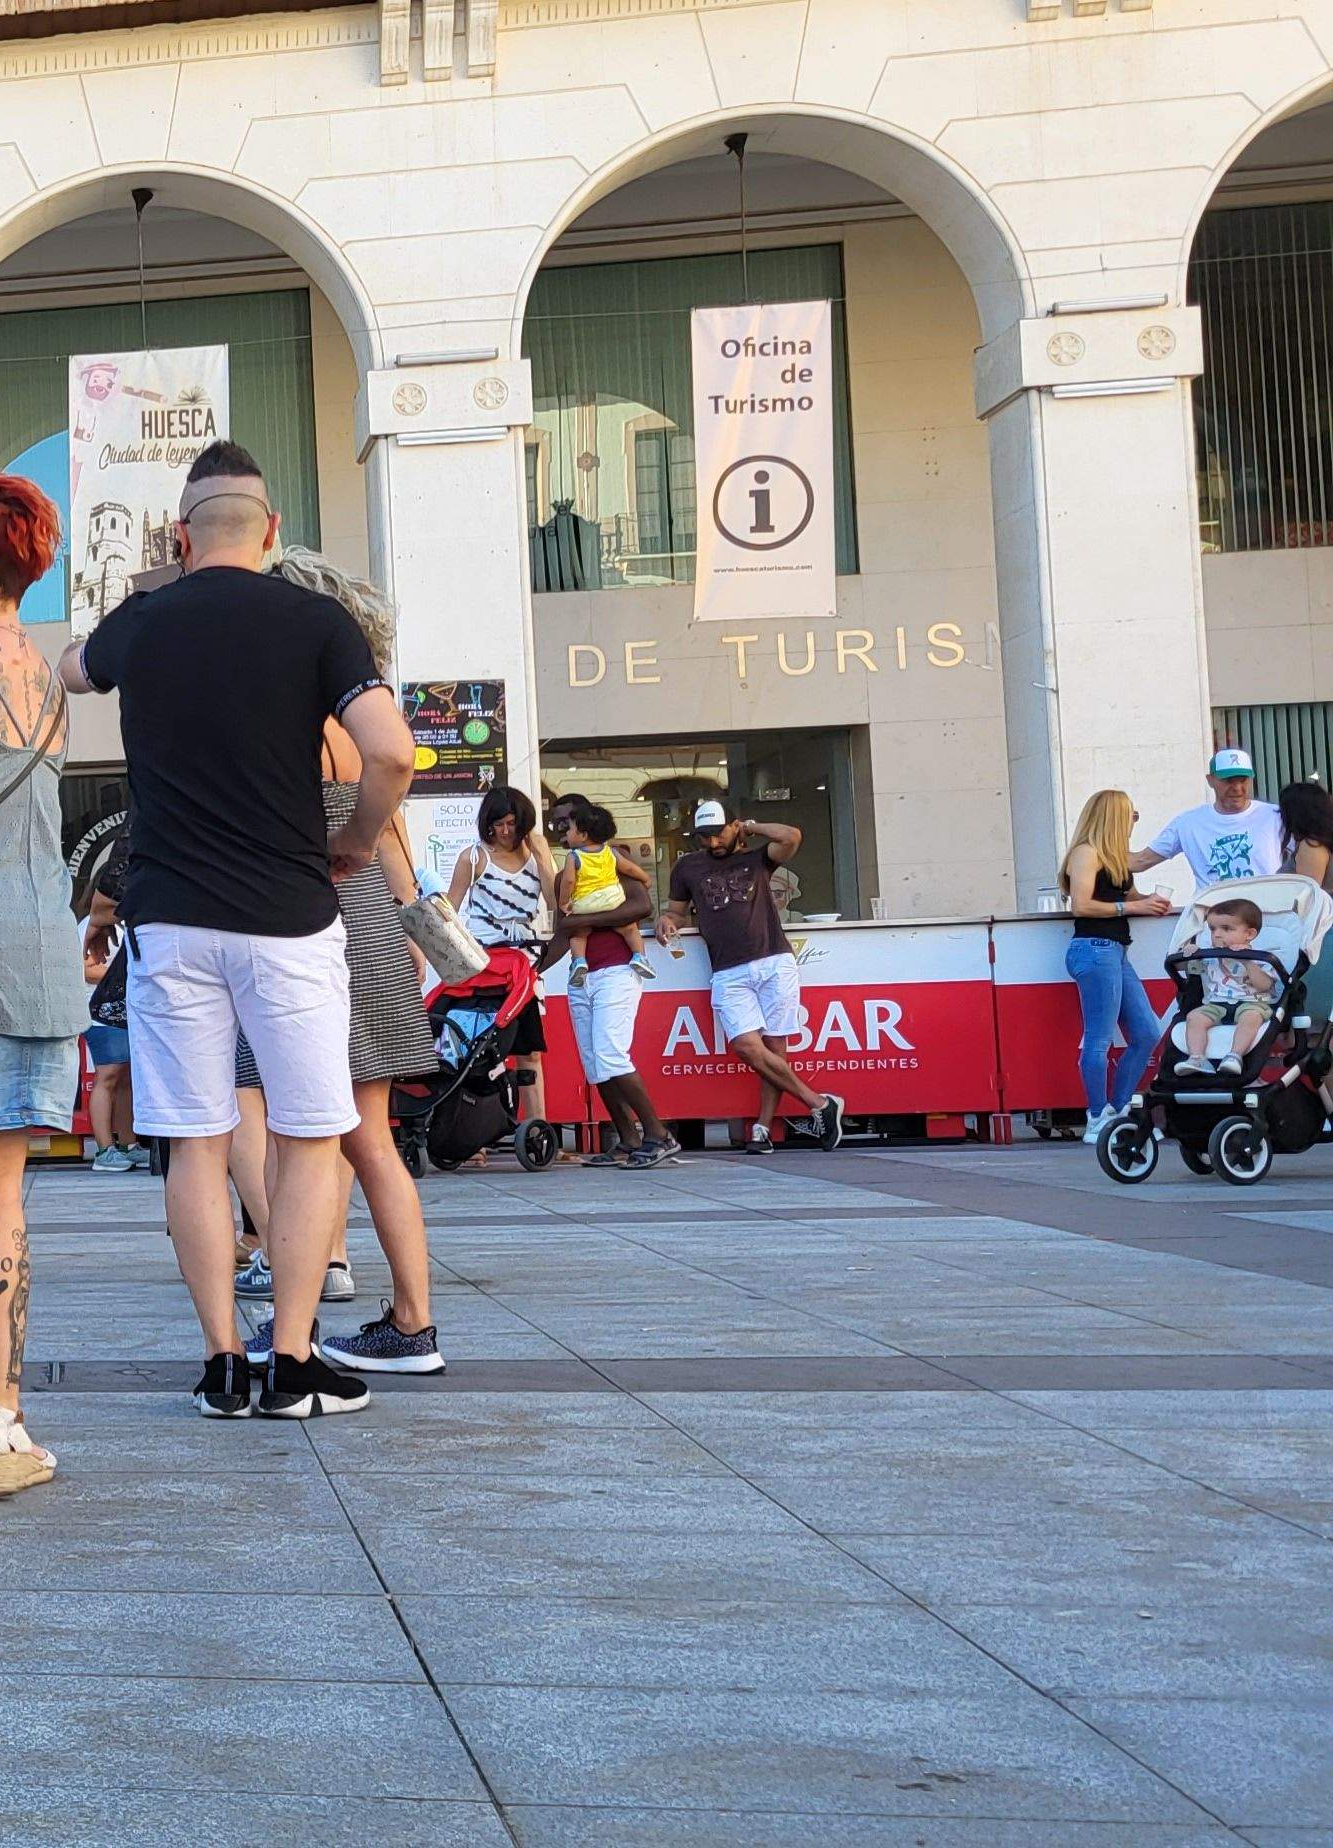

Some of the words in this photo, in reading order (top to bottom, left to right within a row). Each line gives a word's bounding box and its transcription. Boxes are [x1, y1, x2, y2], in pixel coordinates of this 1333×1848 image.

[721, 336, 813, 359] Oficina
[780, 363, 814, 384] de
[708, 394, 814, 415] Turismo
[141, 408, 217, 440] HUESCA
[99, 443, 144, 470] Ciudad
[147, 443, 163, 462] de
[166, 441, 207, 469] leyend
[568, 641, 661, 687] DE
[722, 622, 1000, 680] TURIS
[440, 805, 473, 814] SOLO
[435, 819, 476, 828] EFECTIV
[662, 999, 916, 1056] ABAR
[662, 1064, 756, 1075] CERVECERO
[790, 1058, 919, 1072] DEPENDIENTES
